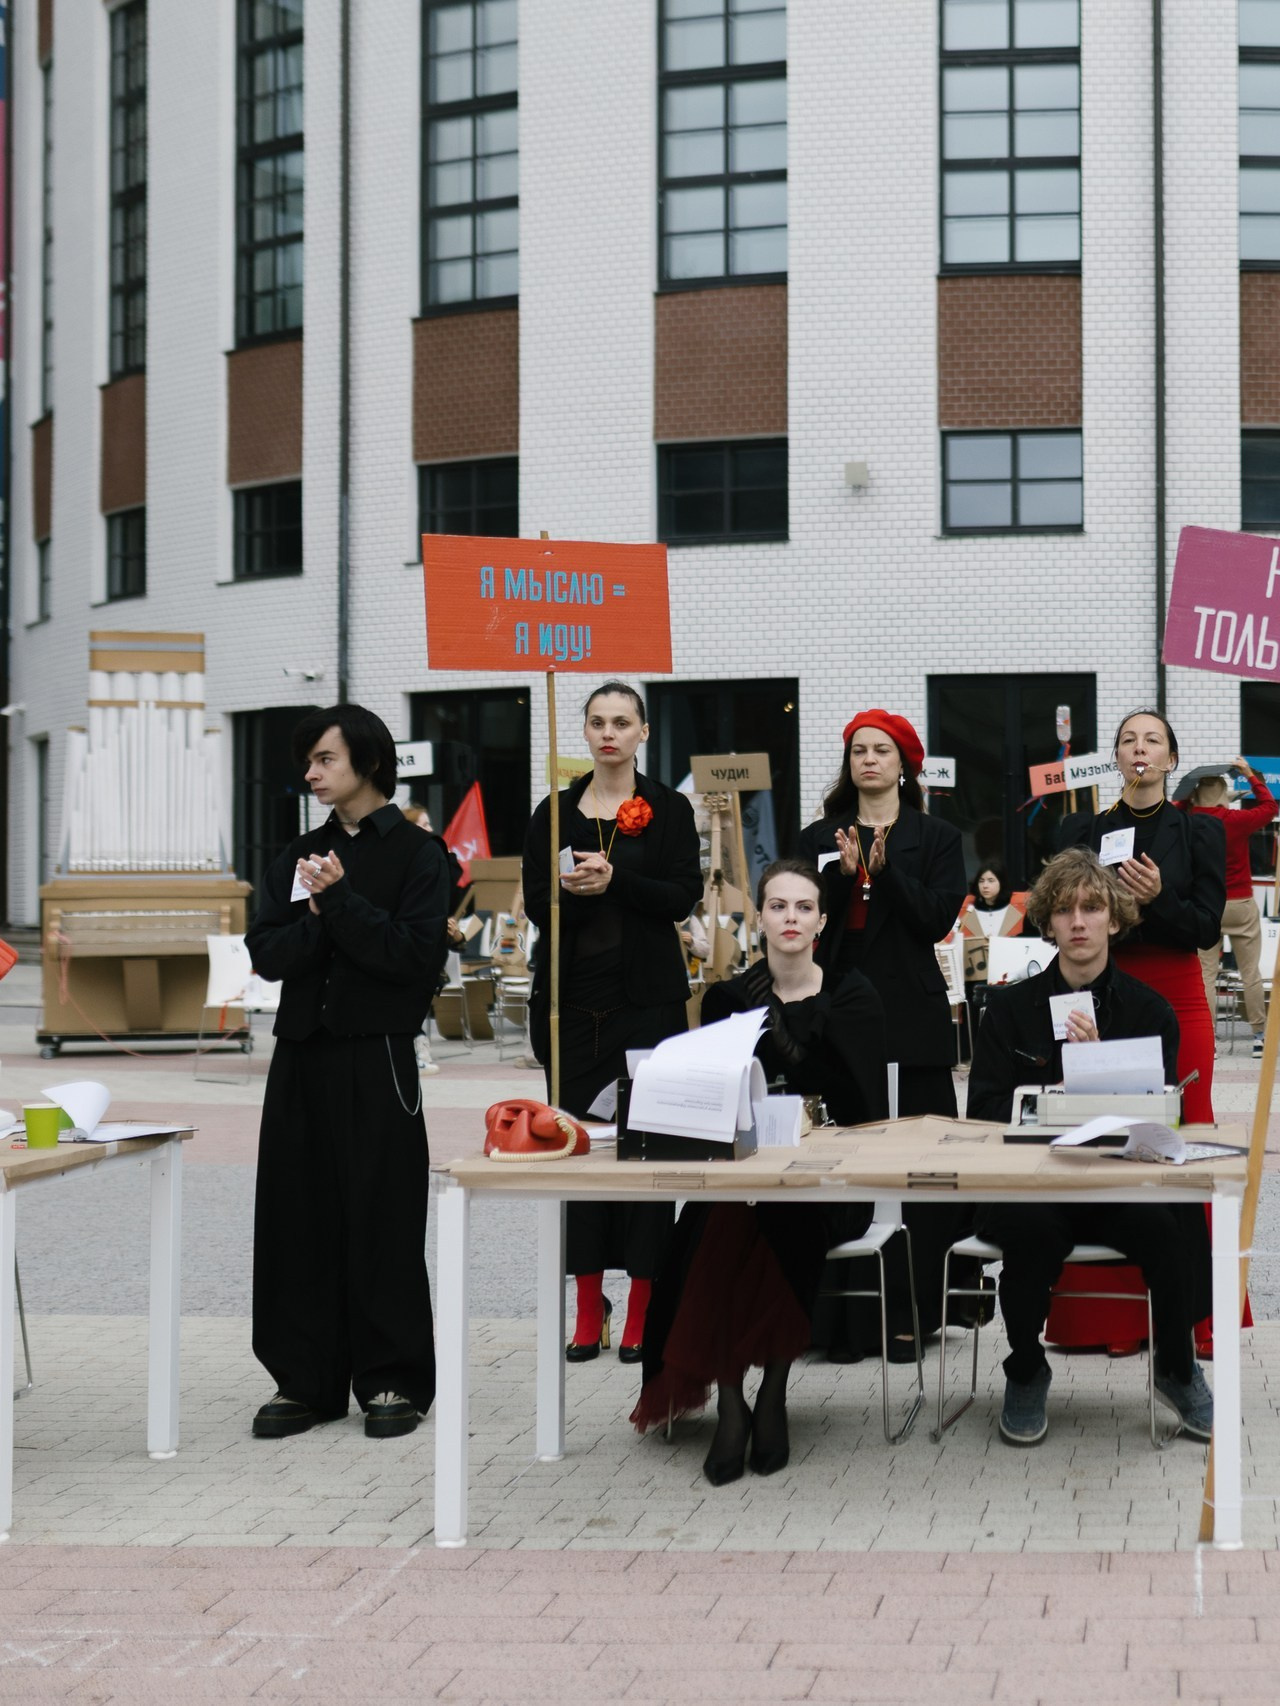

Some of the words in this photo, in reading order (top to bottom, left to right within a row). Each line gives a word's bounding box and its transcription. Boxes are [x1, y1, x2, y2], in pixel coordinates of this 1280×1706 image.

[480, 566, 495, 599] Я
[505, 567, 604, 605] МЫСЛЮ
[515, 622, 529, 654] Я
[711, 768, 750, 782] ЧУДИ!
